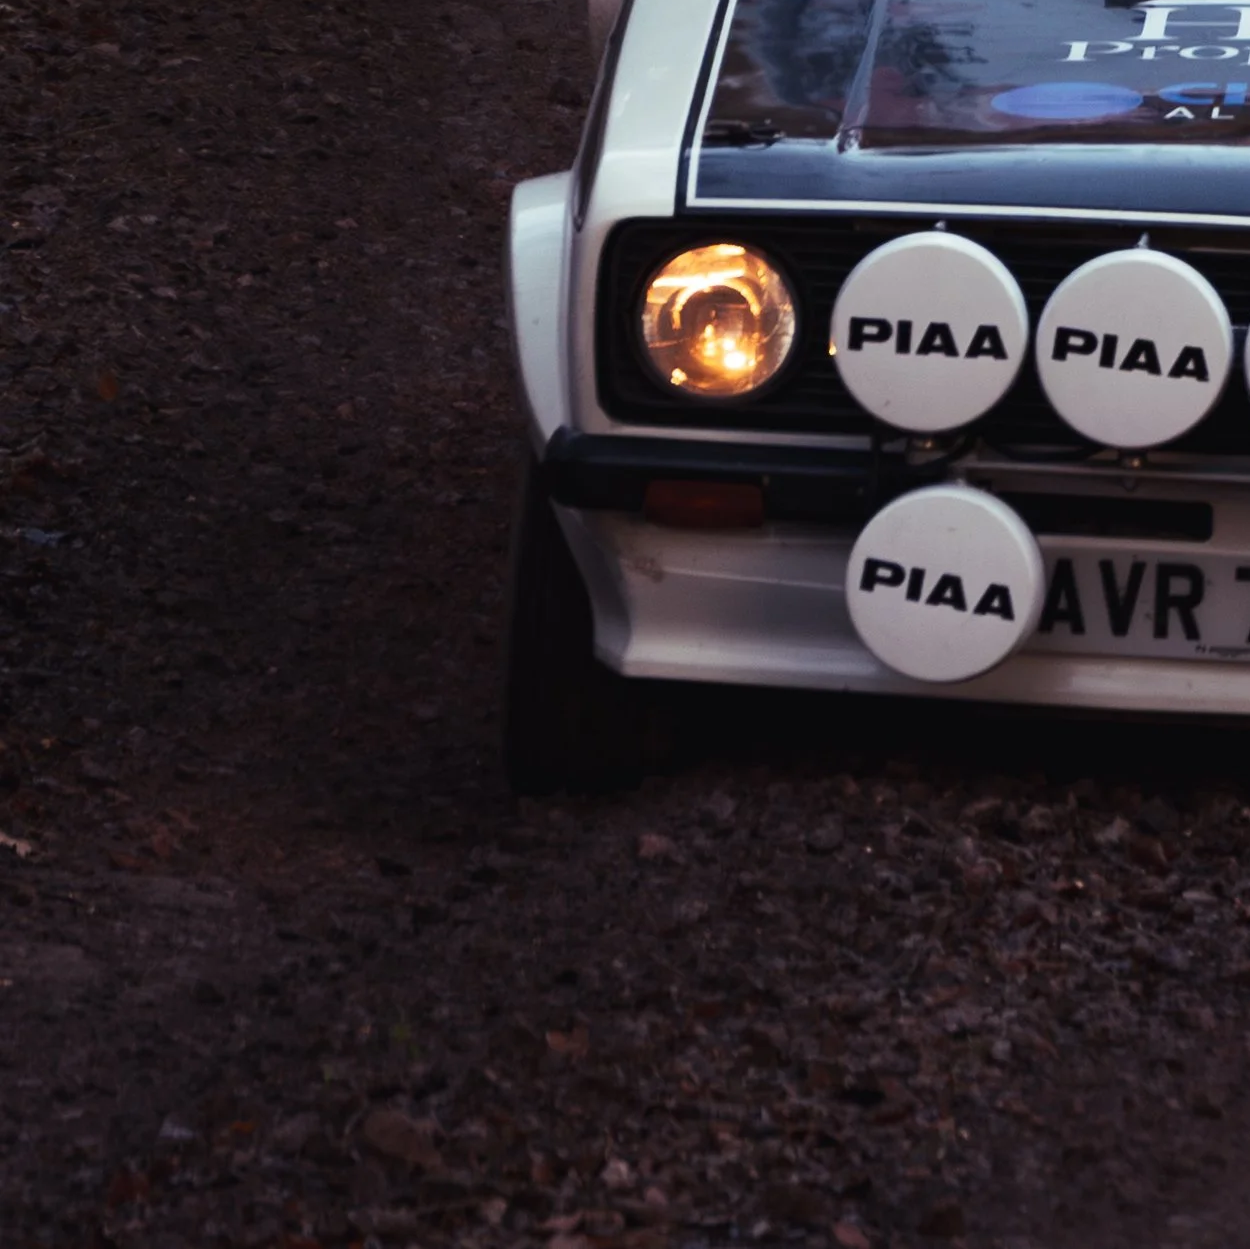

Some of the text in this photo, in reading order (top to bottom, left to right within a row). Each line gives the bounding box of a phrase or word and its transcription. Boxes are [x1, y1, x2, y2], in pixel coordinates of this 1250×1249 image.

[848, 317, 1009, 360] PIAA
[1051, 326, 1210, 383] PIAA
[859, 557, 1015, 622] PIAA
[1038, 557, 1205, 641] AVR
